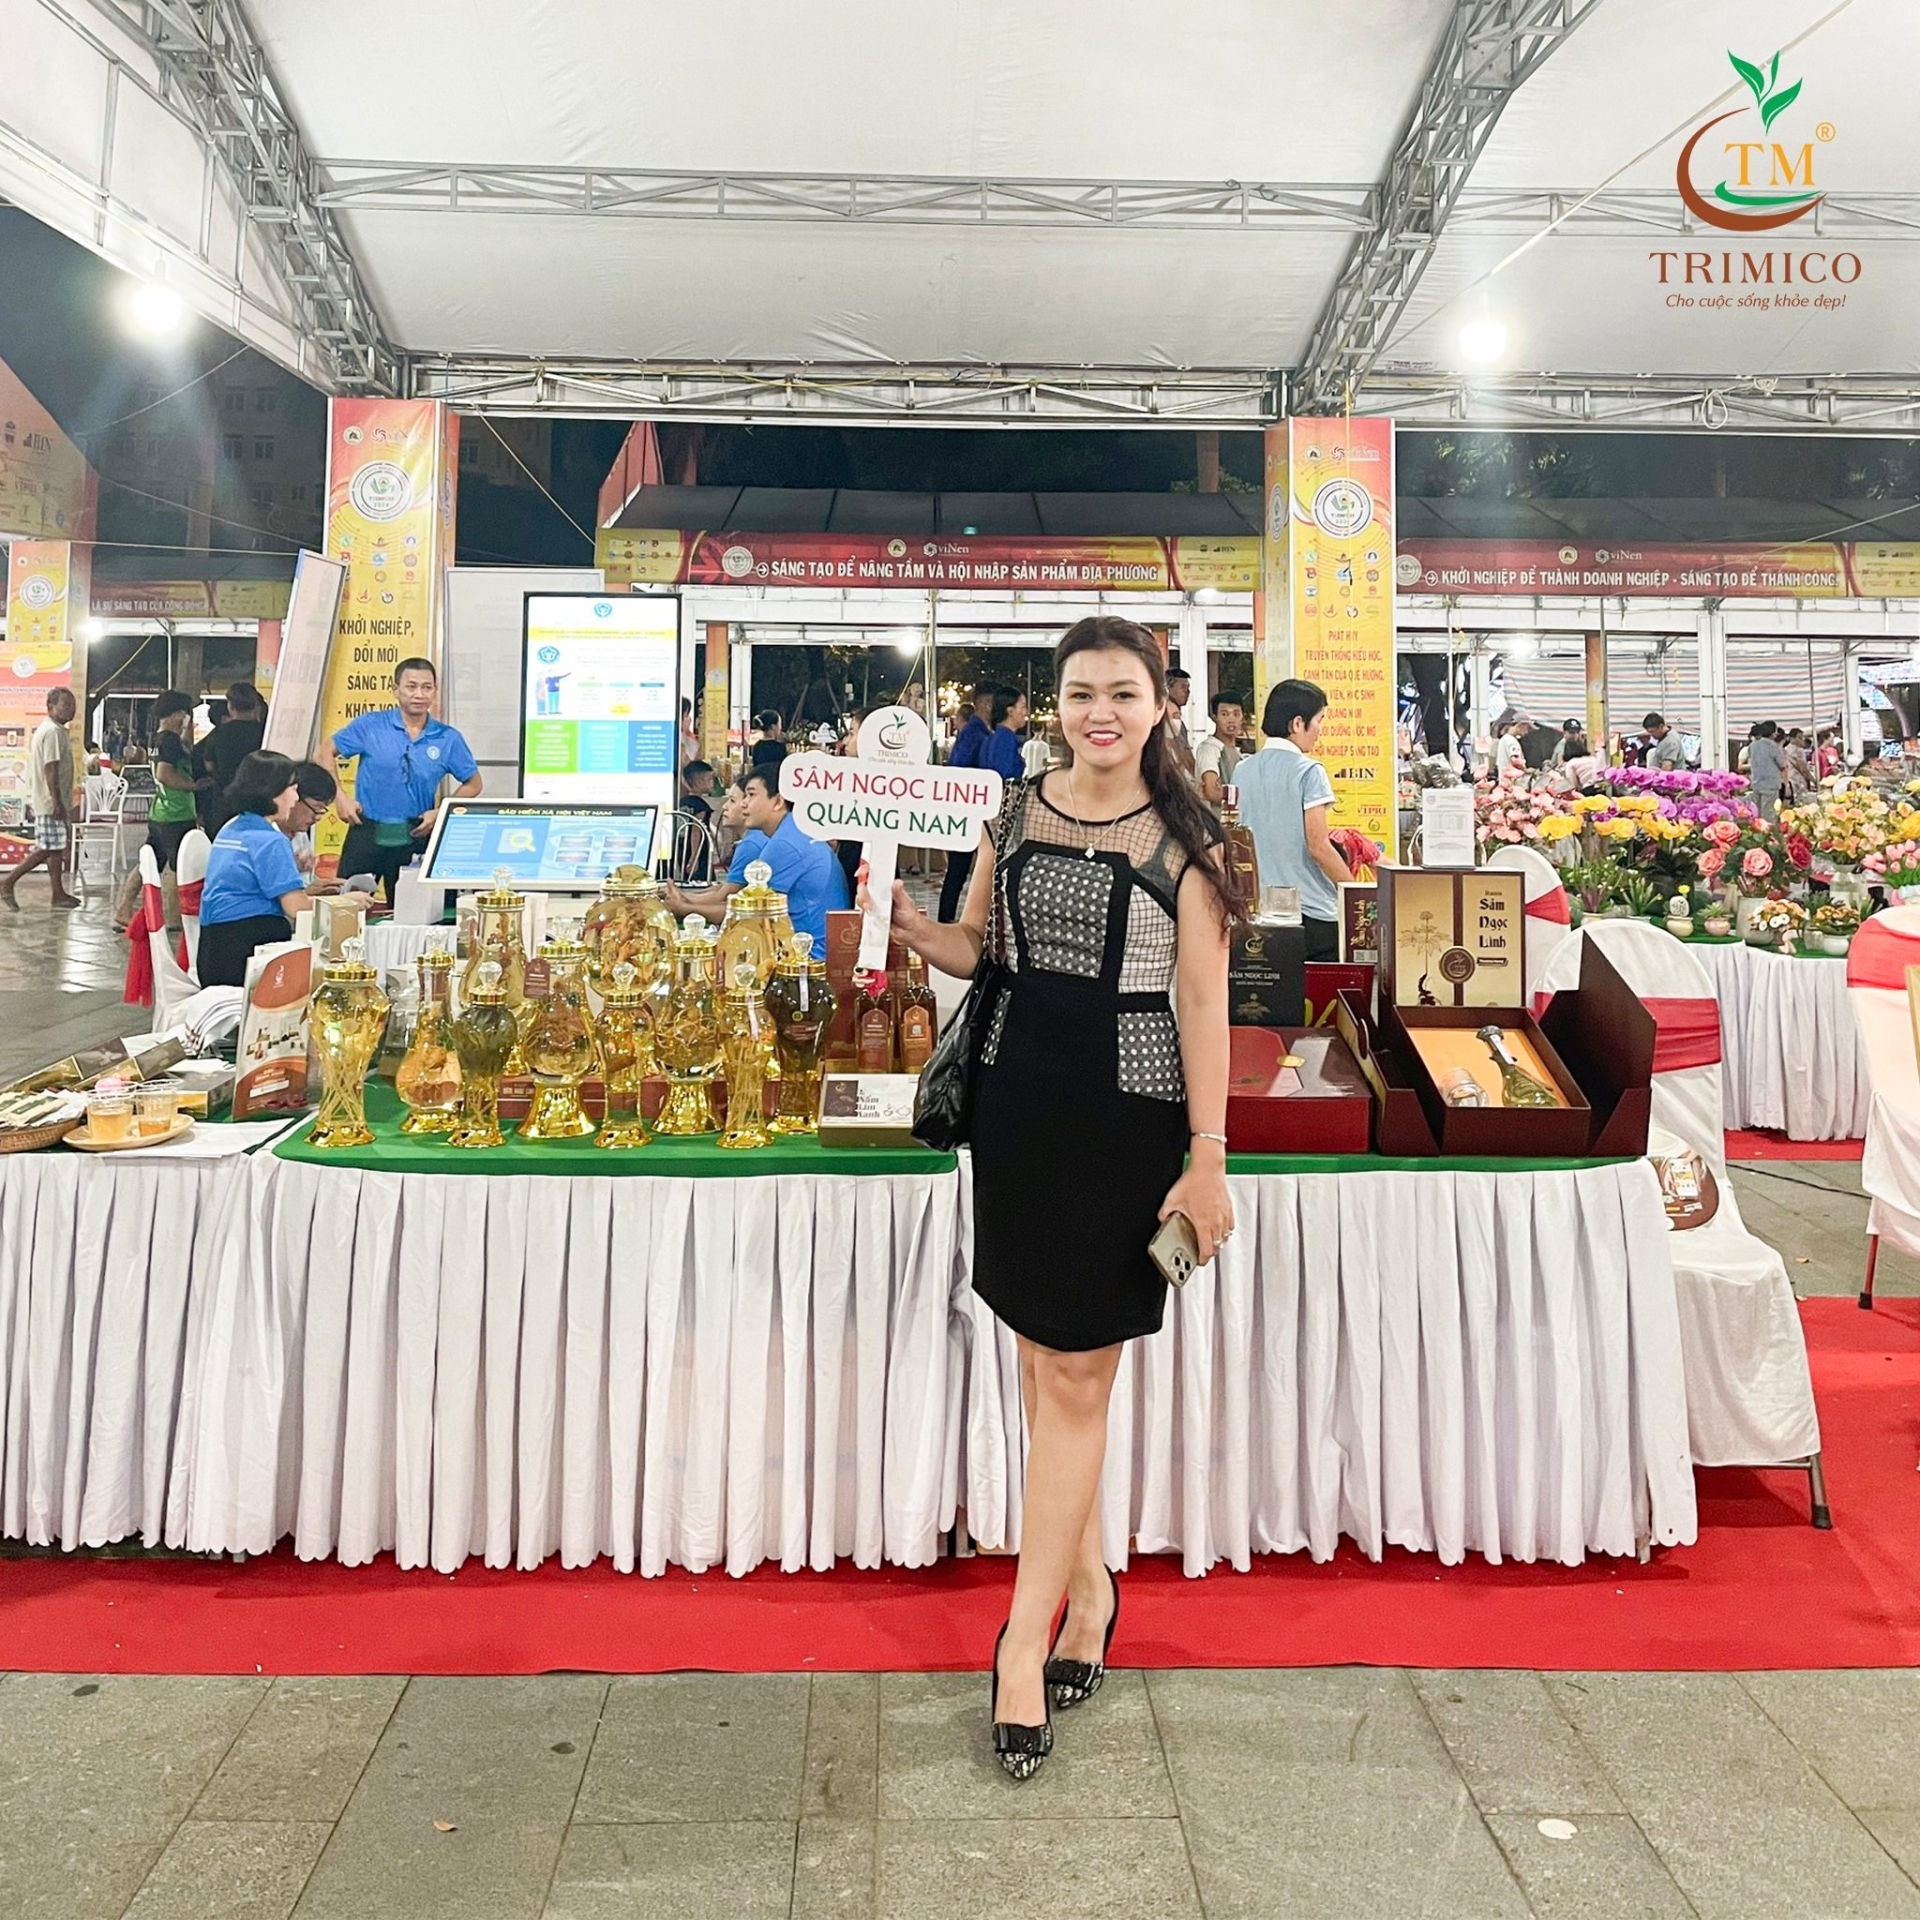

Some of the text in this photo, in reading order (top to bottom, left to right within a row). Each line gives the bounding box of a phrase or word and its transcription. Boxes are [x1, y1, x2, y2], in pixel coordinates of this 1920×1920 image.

[938, 543, 969, 554] viNen
[1610, 549, 1643, 560] viNen
[771, 555, 1157, 582] SÁNG TẠO ĐỂ NÂNG TẦM VÀ HỘI NHẬP SẢN PHẨM ĐỊA PHƯƠNG
[1441, 565, 1470, 584] KHỞI
[1474, 568, 1516, 588] NGHIỆP
[1520, 564, 1537, 584] ĐỂ
[1540, 566, 1580, 585] THÀNH
[1583, 571, 1623, 585] DOANH
[1626, 569, 1669, 588] NGHIỆP
[1680, 568, 1710, 586] SÁNG
[1715, 572, 1738, 589] TẠO
[1741, 564, 1759, 586] ĐỂ
[1761, 570, 1800, 586] THÀNH
[114, 598, 132, 611] SÁNG
[339, 614, 414, 638] KHỞI NGHIỆP,
[354, 639, 398, 662] ĐỔI MỚI
[347, 671, 394, 694] SÁNG TẠ
[1347, 689, 1359, 701] HC
[1348, 707, 1362, 719] NM
[1349, 768, 1374, 778] BIN
[792, 766, 989, 806] SÂM NGỌC LINH
[807, 800, 968, 837] QUẢNG NAM
[1479, 916, 1508, 931] Ngọc
[1479, 935, 1507, 949] Linh
